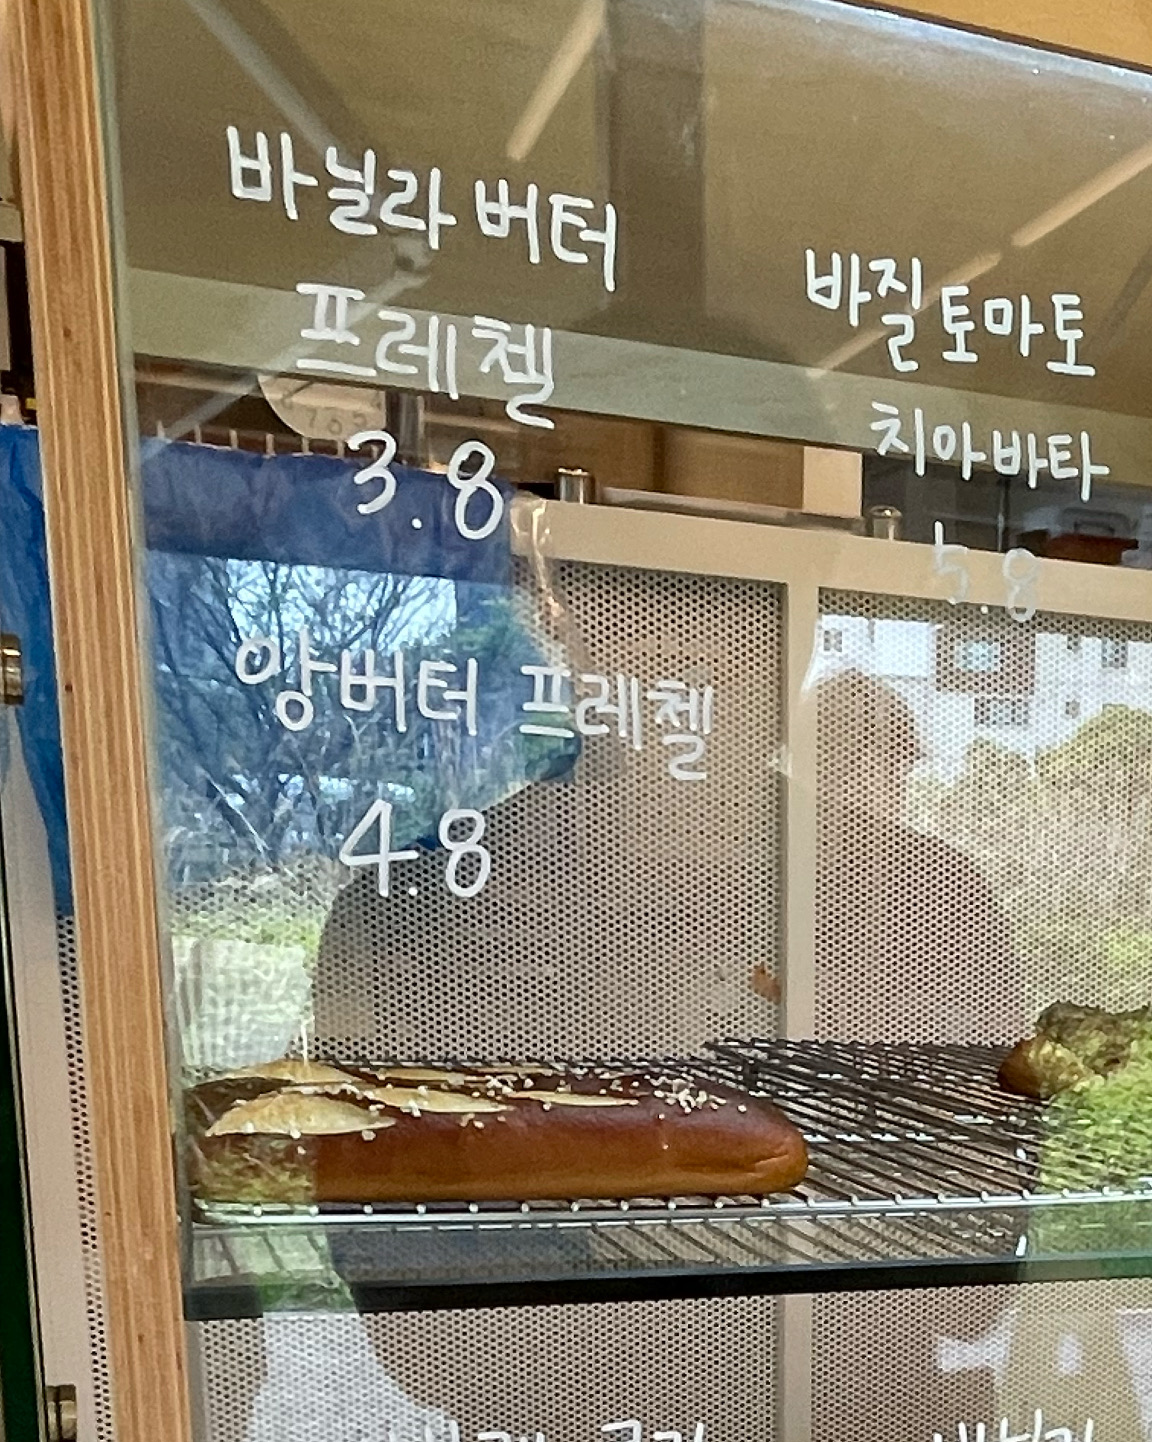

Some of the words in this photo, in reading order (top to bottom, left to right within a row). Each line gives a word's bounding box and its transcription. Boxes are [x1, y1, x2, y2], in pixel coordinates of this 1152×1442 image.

[226, 126, 456, 249] 바닐라
[475, 179, 617, 291] 버터
[296, 283, 556, 429] 프레첼
[347, 430, 504, 539] 3.8
[870, 401, 1110, 501] 치아바타
[932, 521, 1042, 622] 5.8
[236, 628, 478, 736] 앙버터
[519, 665, 714, 781] 프레첼
[339, 799, 492, 897] 4.8
